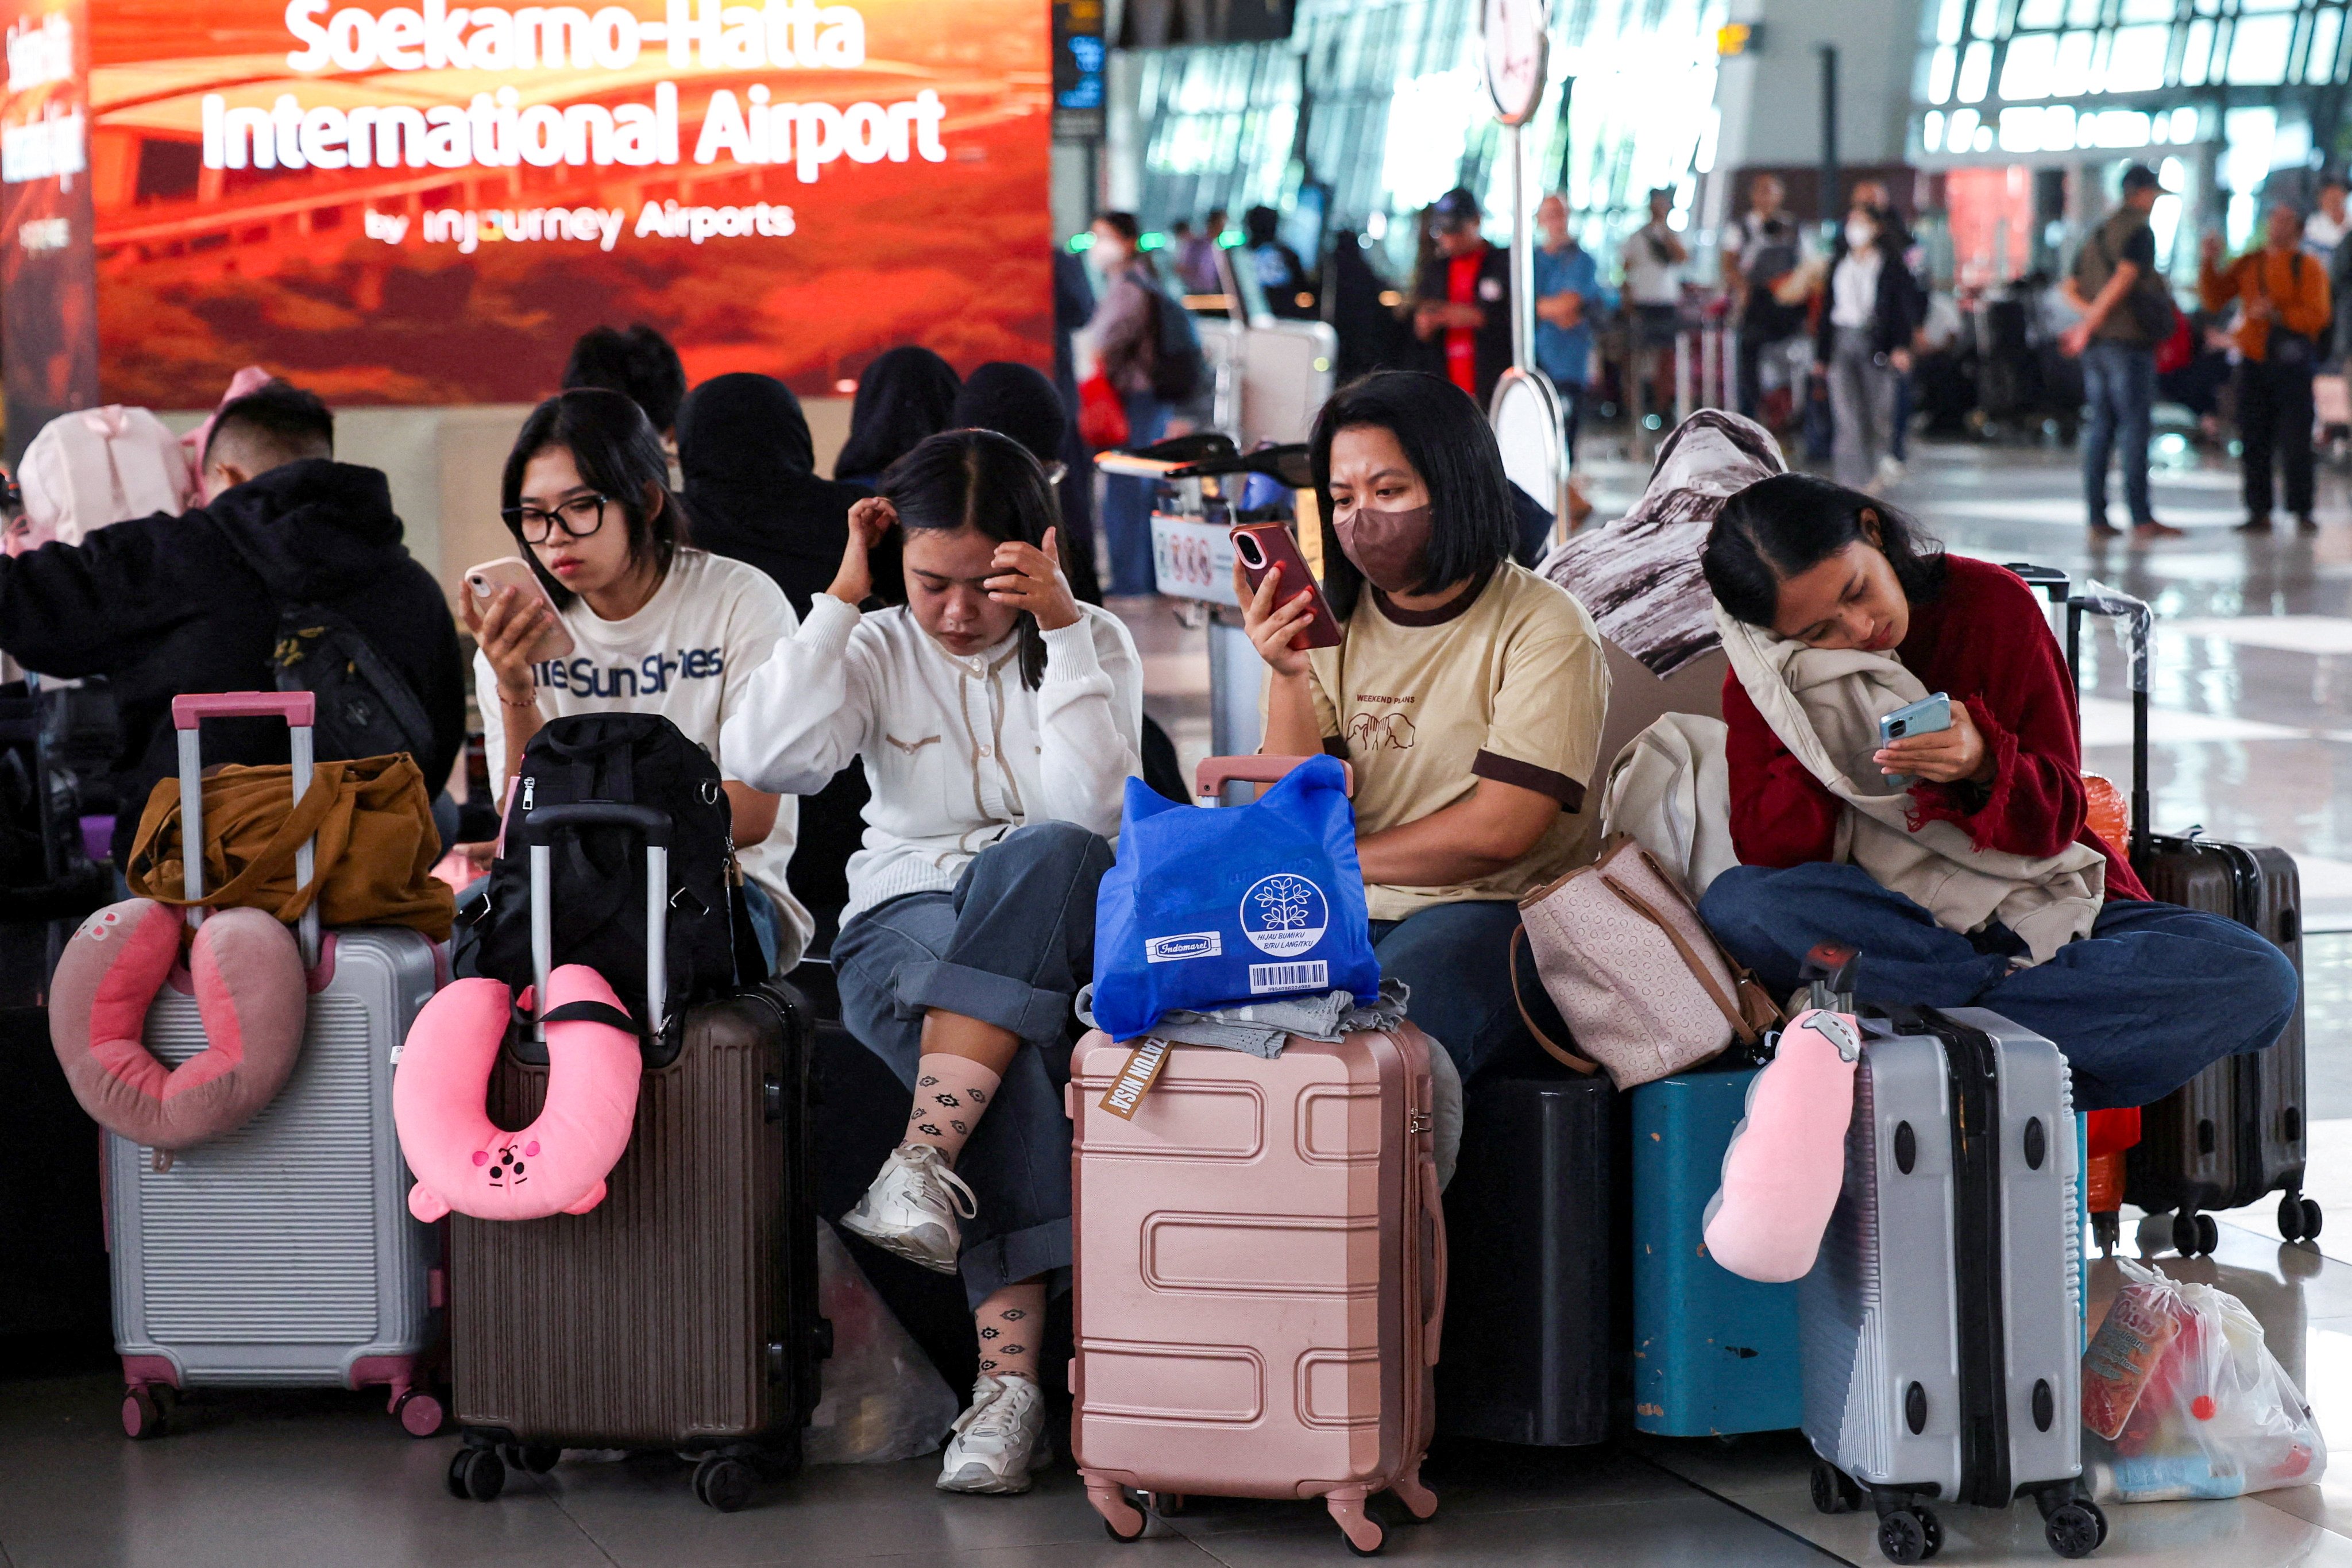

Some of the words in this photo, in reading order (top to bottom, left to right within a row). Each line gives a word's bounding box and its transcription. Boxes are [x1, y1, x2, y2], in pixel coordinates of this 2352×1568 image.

[284, 0, 865, 71] Soekarno-Hatta
[202, 81, 679, 169] International
[694, 83, 947, 183] Airport
[365, 208, 410, 245] by
[634, 199, 796, 244] Airports
[570, 658, 638, 698] Sun
[1357, 694, 1392, 704] WEEKEND
[1393, 696, 1415, 704] PLANS
[1160, 940, 1207, 953] Indomaret
[1257, 933, 1277, 941] HIJAU
[1280, 940, 1314, 948] LANGITKU
